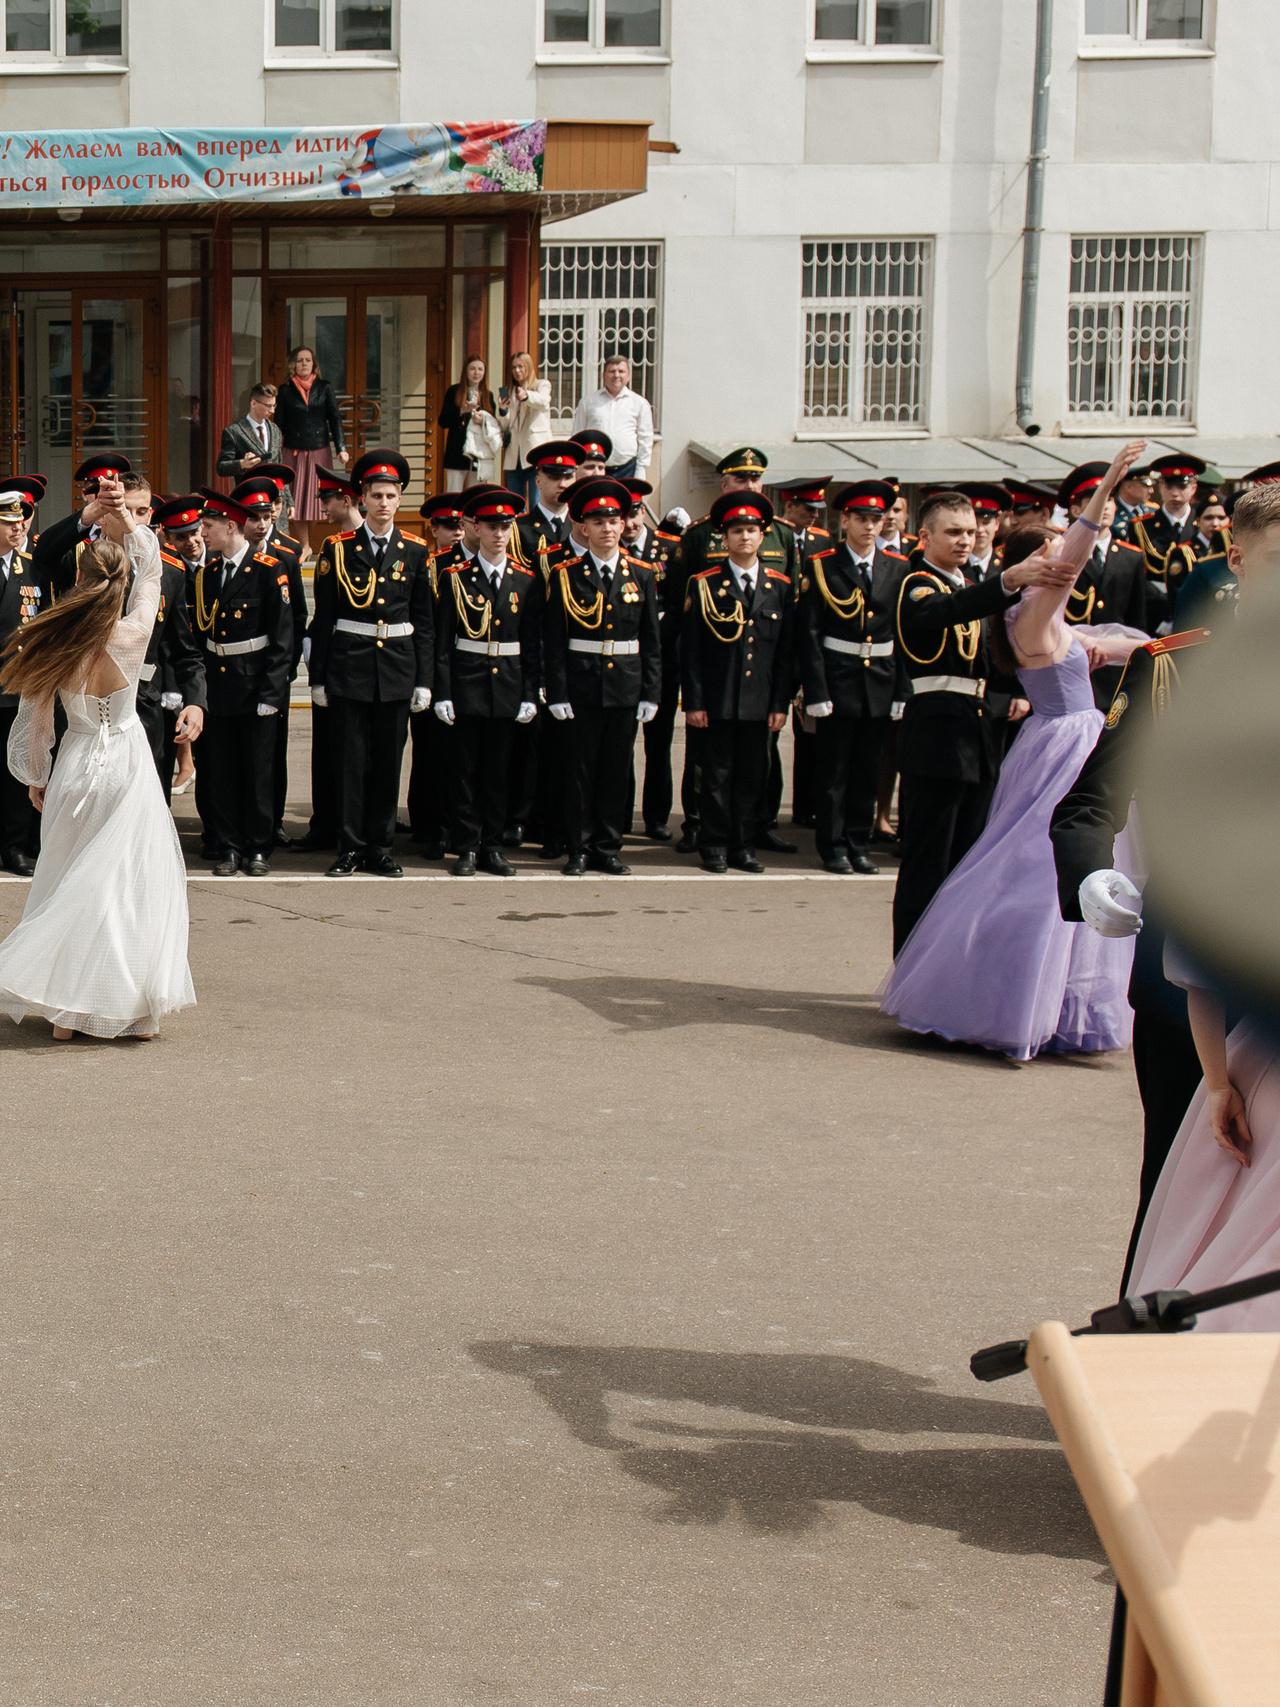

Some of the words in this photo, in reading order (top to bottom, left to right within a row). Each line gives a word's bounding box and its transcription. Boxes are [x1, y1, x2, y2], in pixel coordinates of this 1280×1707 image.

[25, 139, 123, 159] Желаем
[137, 141, 183, 157] вам
[197, 140, 282, 161] вперед
[296, 138, 349, 153] идти
[62, 173, 190, 197] гордостью
[204, 164, 323, 189] Отчизны!
